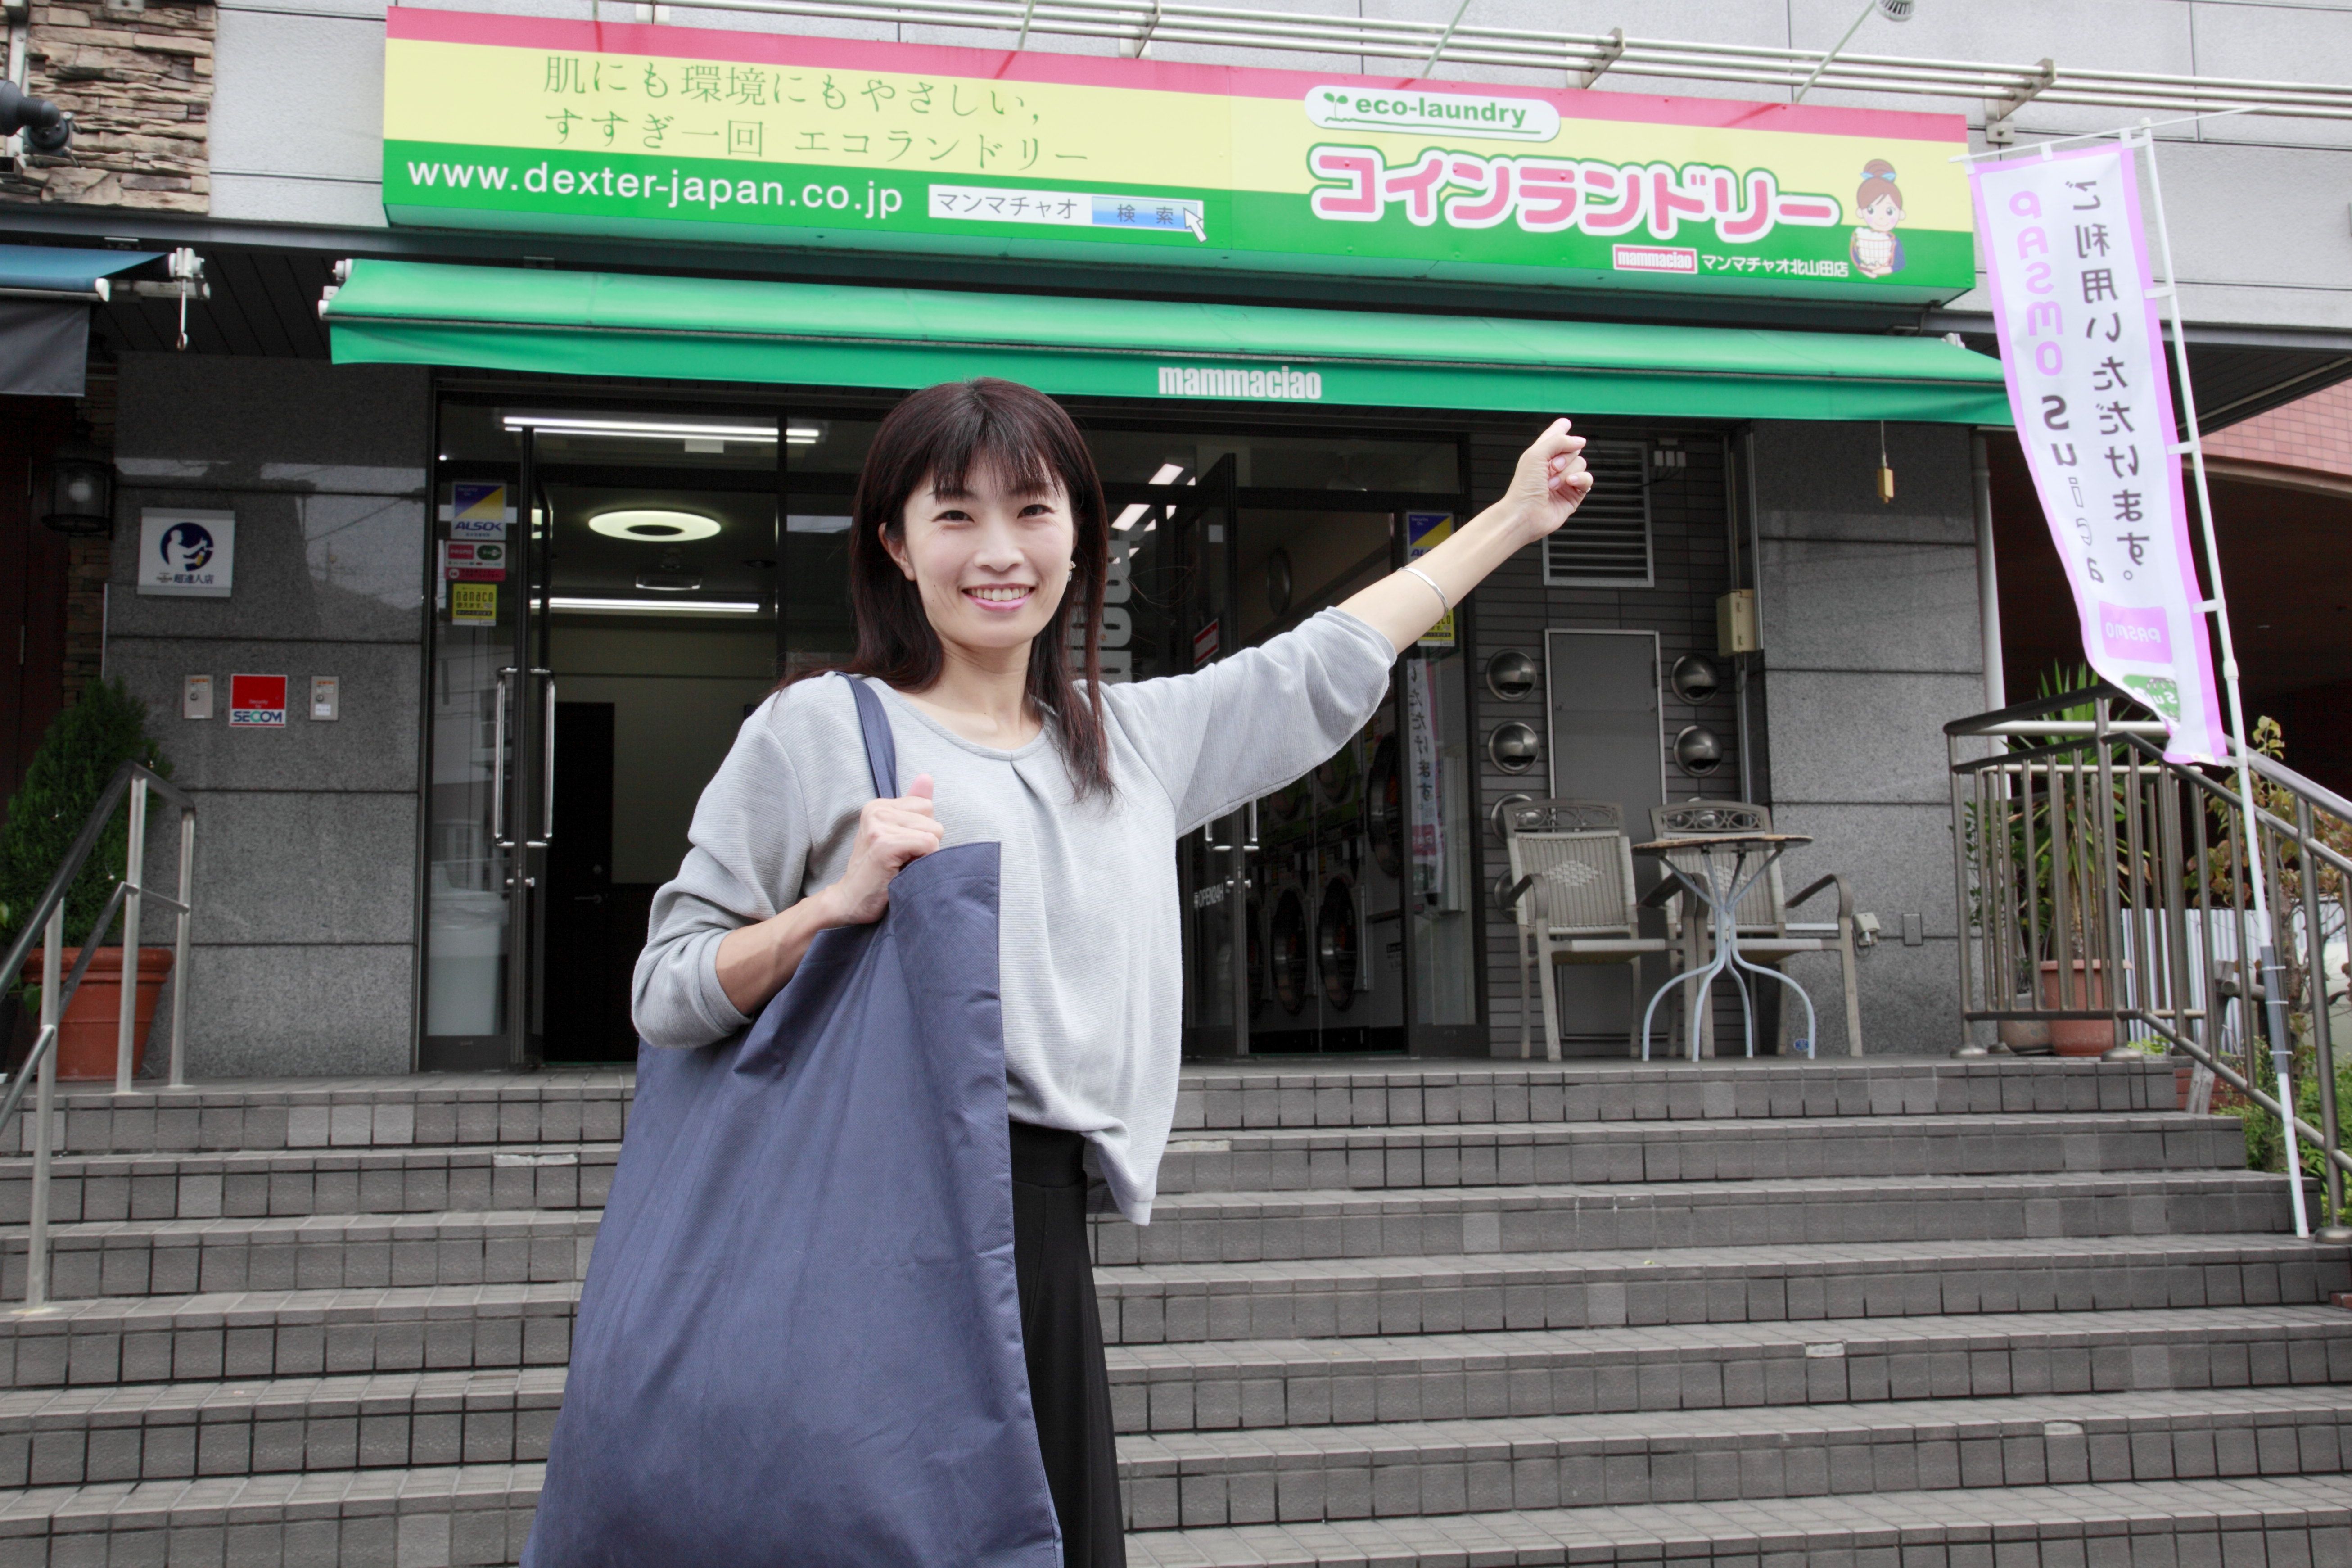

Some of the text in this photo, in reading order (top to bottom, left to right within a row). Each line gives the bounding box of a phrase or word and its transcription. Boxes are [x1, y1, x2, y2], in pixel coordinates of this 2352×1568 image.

[1355, 97, 1526, 128] eco-laundry
[545, 108, 1088, 170] すすぎ一回 エコランドリー
[407, 161, 903, 219] www.dexter-japan.co.jp
[1309, 145, 1839, 243] コインランドリー
[937, 191, 1174, 225] マンマチャオ 検索
[1618, 251, 1692, 269] mammaciao
[1702, 254, 1849, 277] マンマチャオ北山田店
[1158, 365, 1322, 400] mammaciao
[455, 521, 502, 532] ALSOK
[456, 591, 494, 602] nanaco
[234, 711, 282, 722] SECOM
